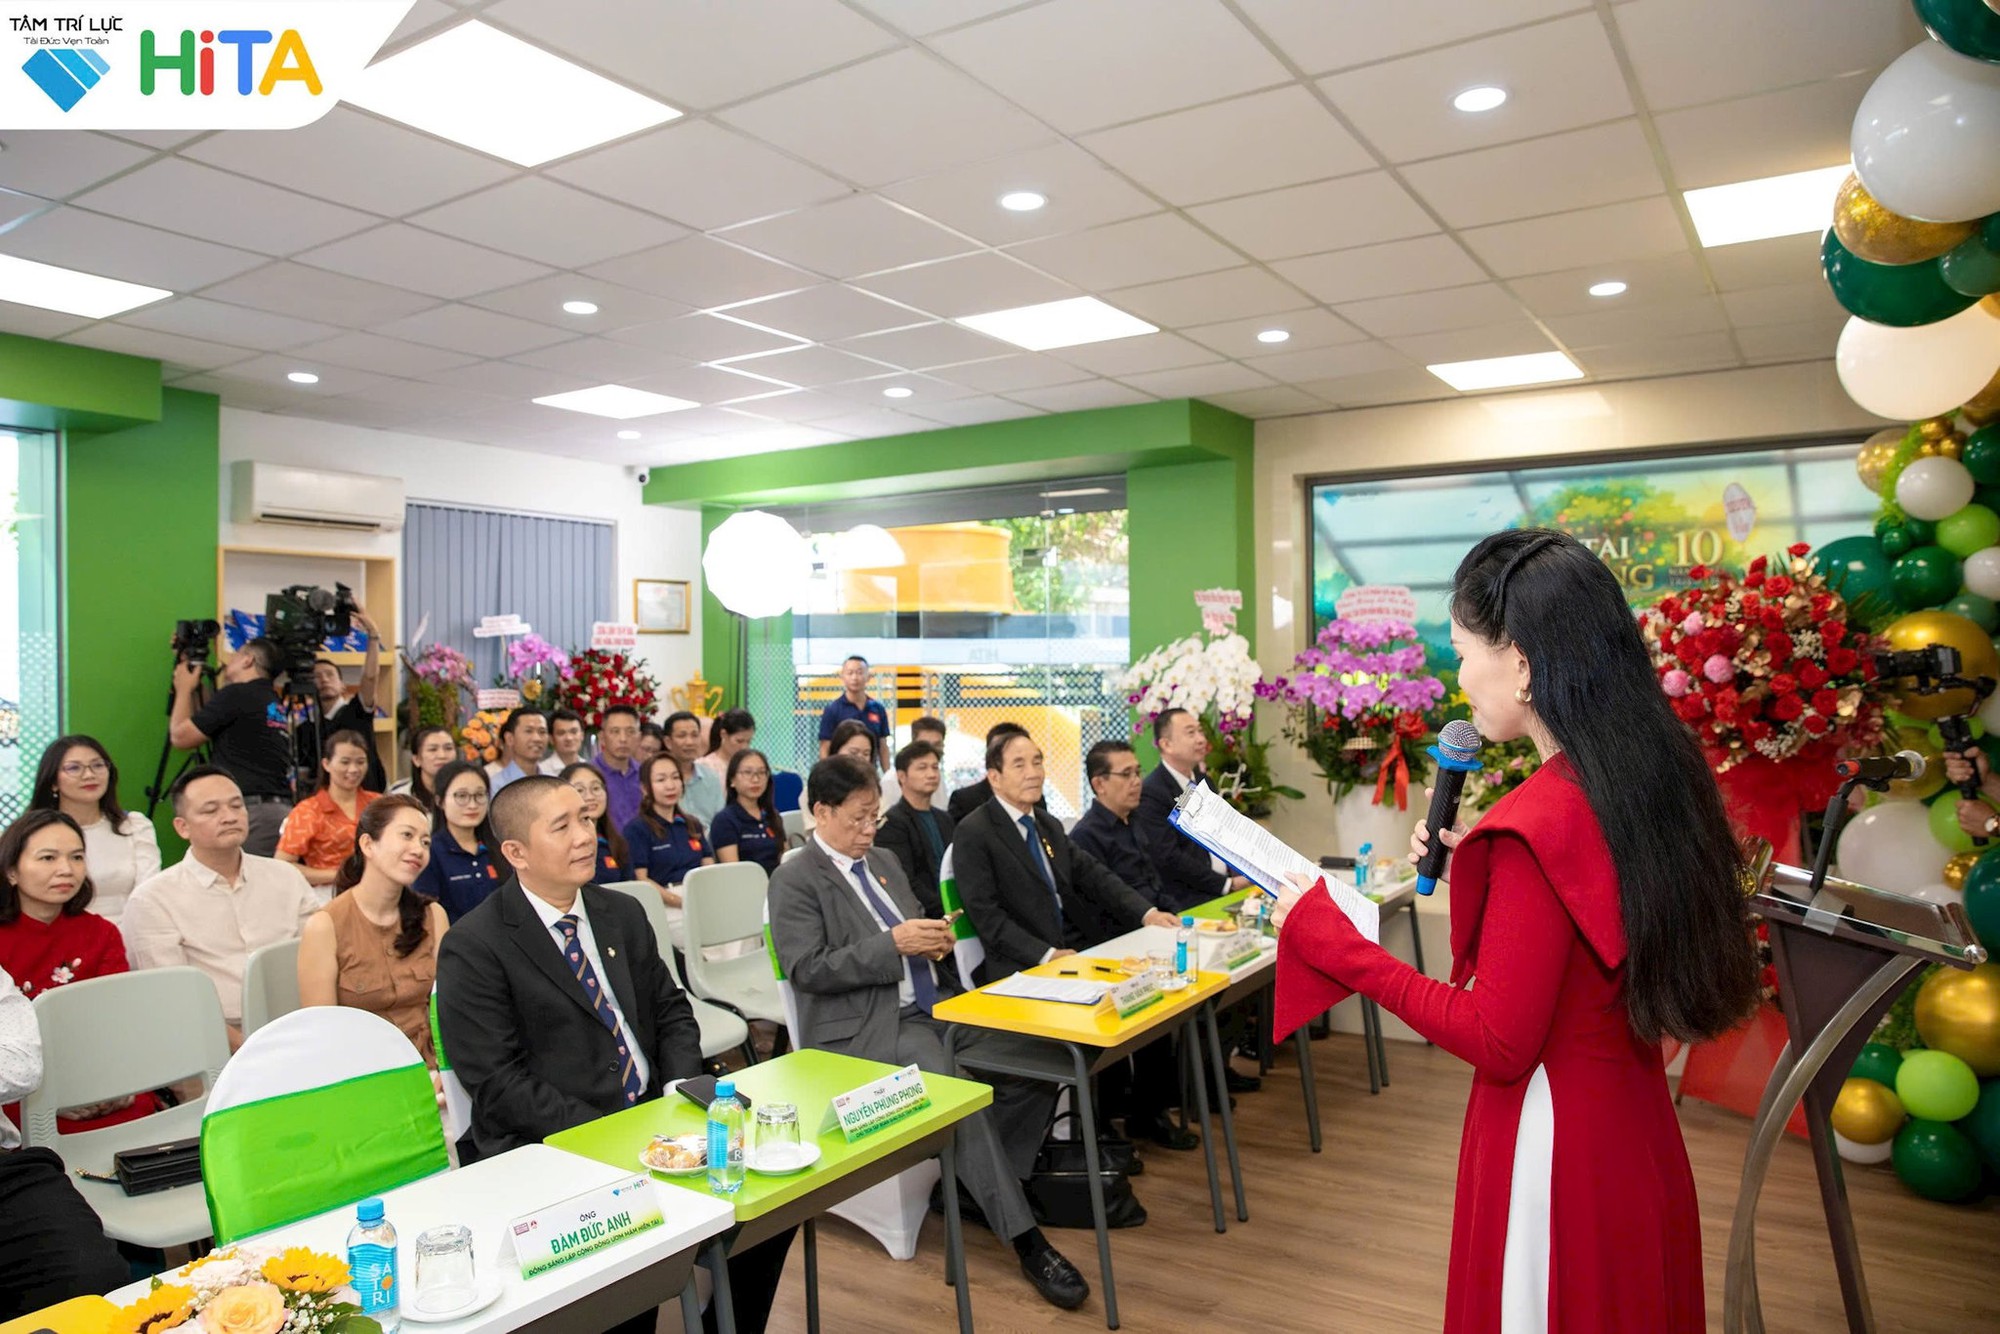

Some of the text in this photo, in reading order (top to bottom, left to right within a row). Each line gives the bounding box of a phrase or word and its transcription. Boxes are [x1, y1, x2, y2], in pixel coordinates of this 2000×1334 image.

[1675, 528, 1723, 567] 10
[579, 1210, 597, 1222] ÔNG
[550, 1211, 631, 1254] ĐÀM ĐỨC ANH
[372, 1290, 391, 1306] RI
